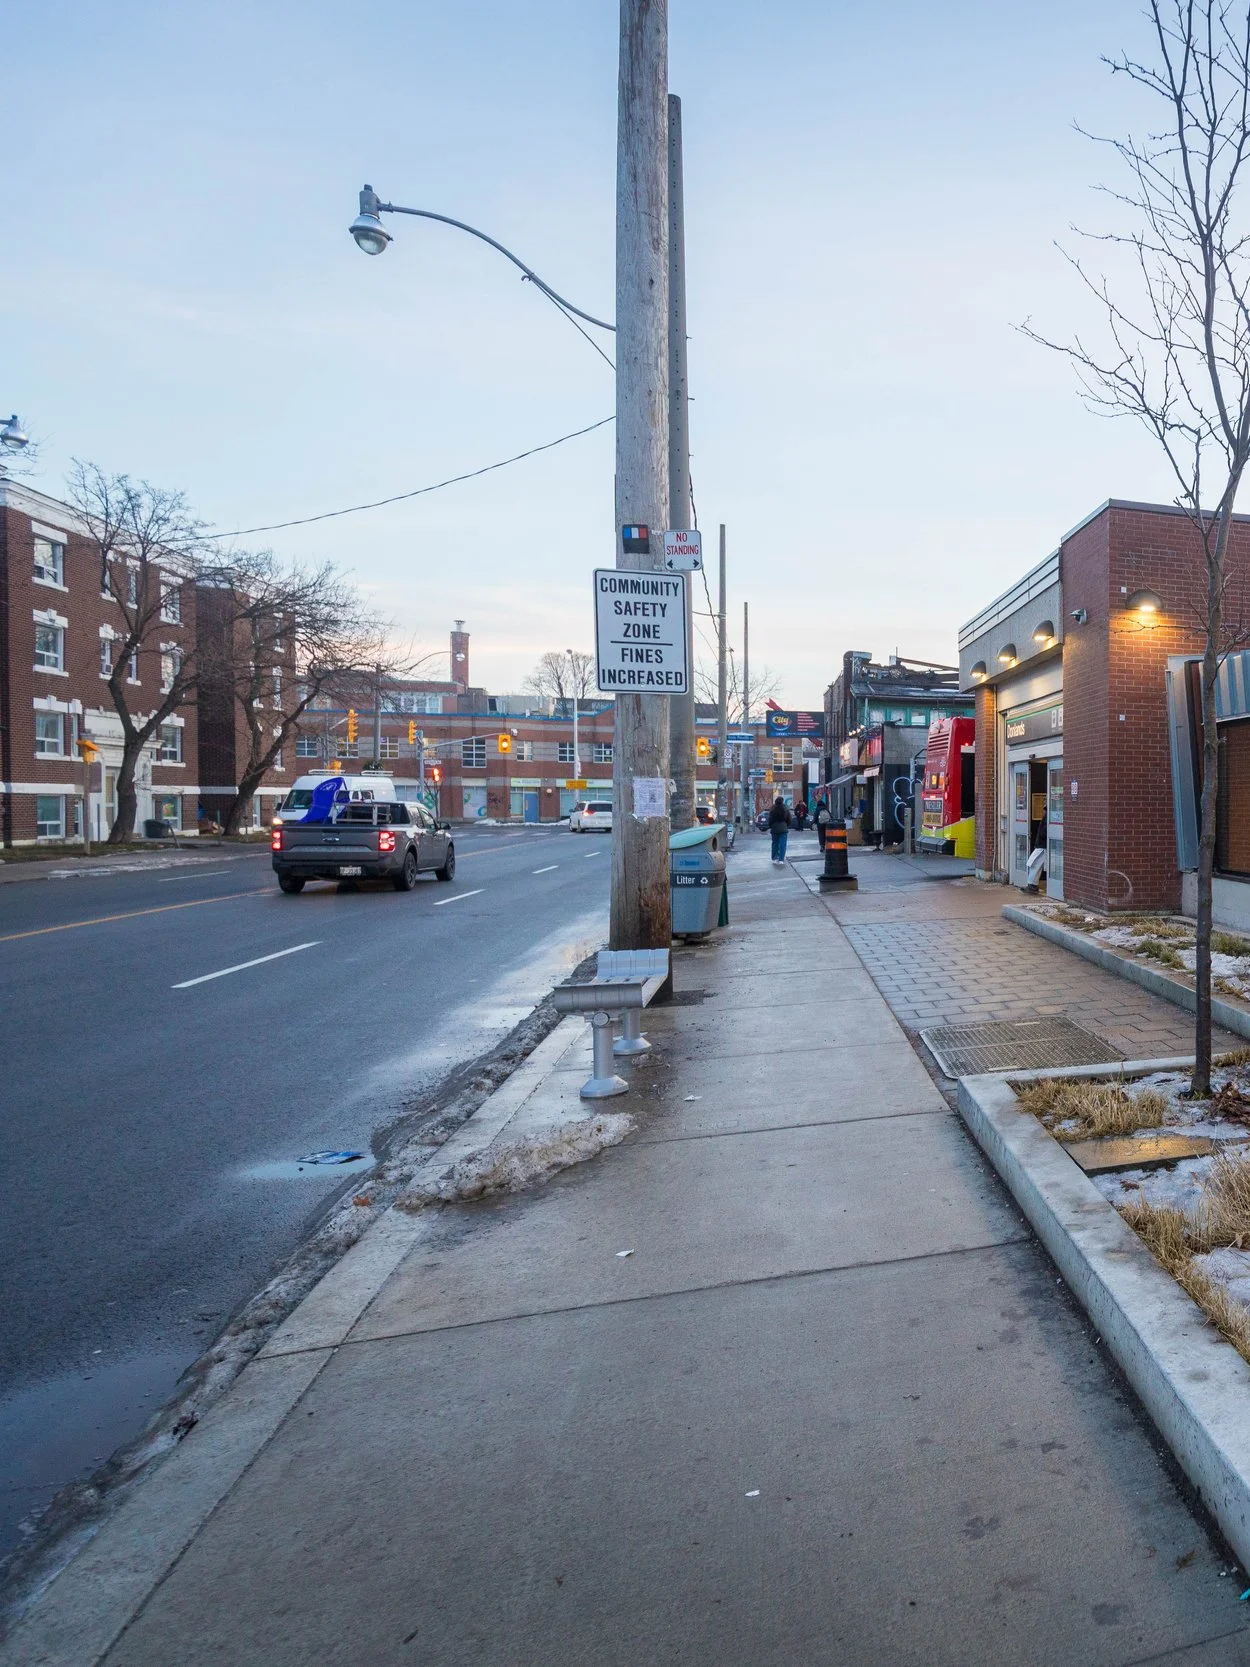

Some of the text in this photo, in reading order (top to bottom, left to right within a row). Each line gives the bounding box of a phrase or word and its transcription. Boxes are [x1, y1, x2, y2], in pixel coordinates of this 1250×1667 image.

[676, 532, 688, 543] NO
[666, 544, 699, 556] STANDING
[600, 577, 680, 597] COMMUNITY
[613, 600, 668, 618] SAFETY
[623, 622, 661, 639] ZONE
[621, 647, 664, 664] FINES
[601, 668, 683, 686] INCREASED
[1007, 722, 1025, 738] Donlands
[676, 875, 696, 885] Litter
